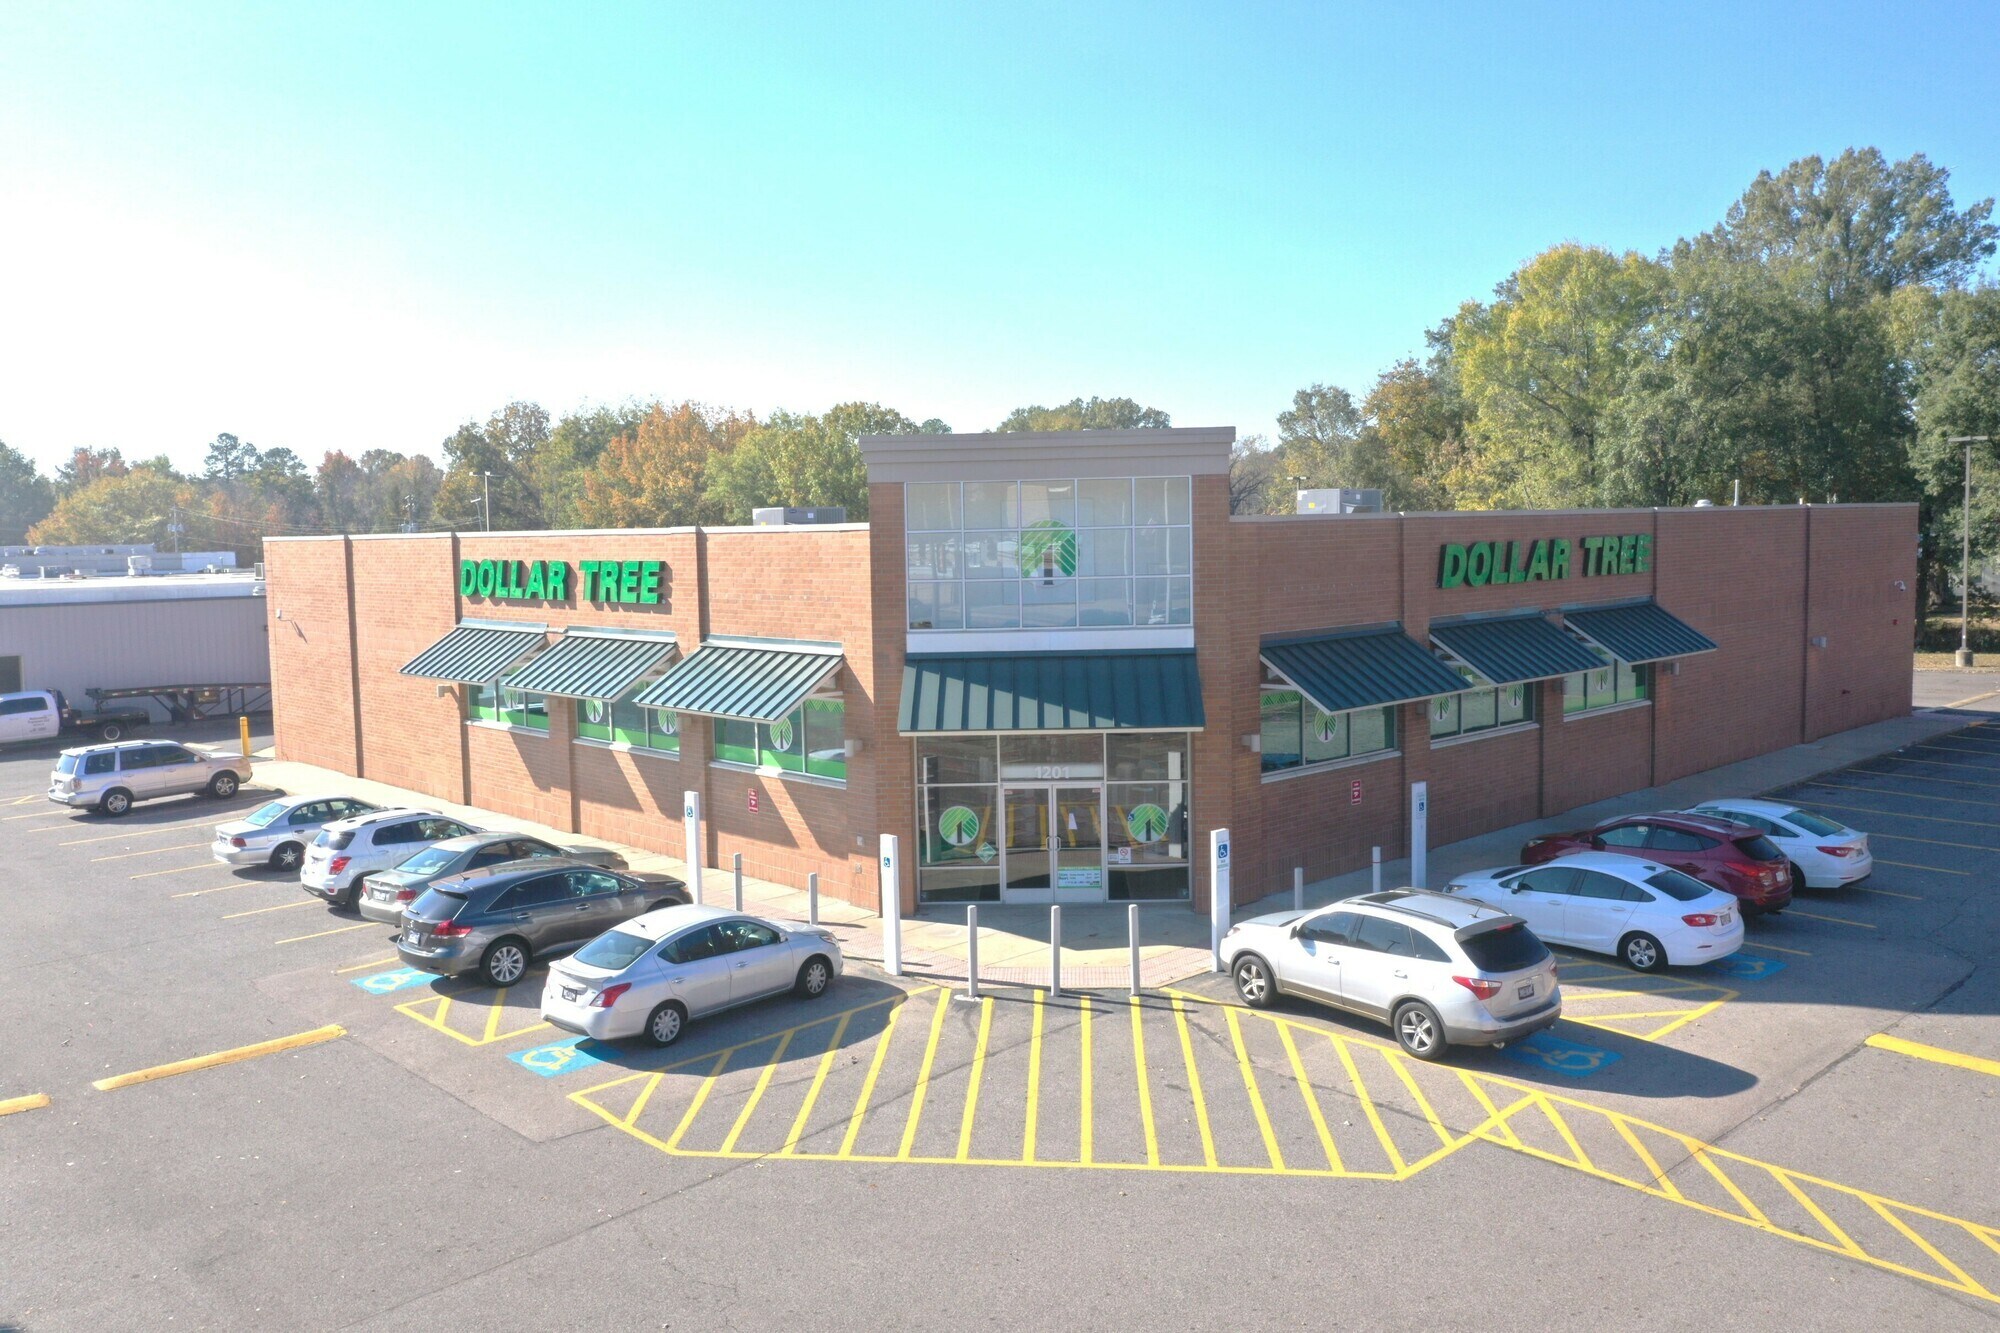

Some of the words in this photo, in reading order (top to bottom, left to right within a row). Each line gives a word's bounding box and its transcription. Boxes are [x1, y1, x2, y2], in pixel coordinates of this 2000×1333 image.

[459, 558, 567, 601] DOLLAR
[579, 559, 661, 605] TREE
[1438, 538, 1573, 589] DOLLAR
[1581, 534, 1653, 577] TREE
[1034, 766, 1070, 779] 1201
